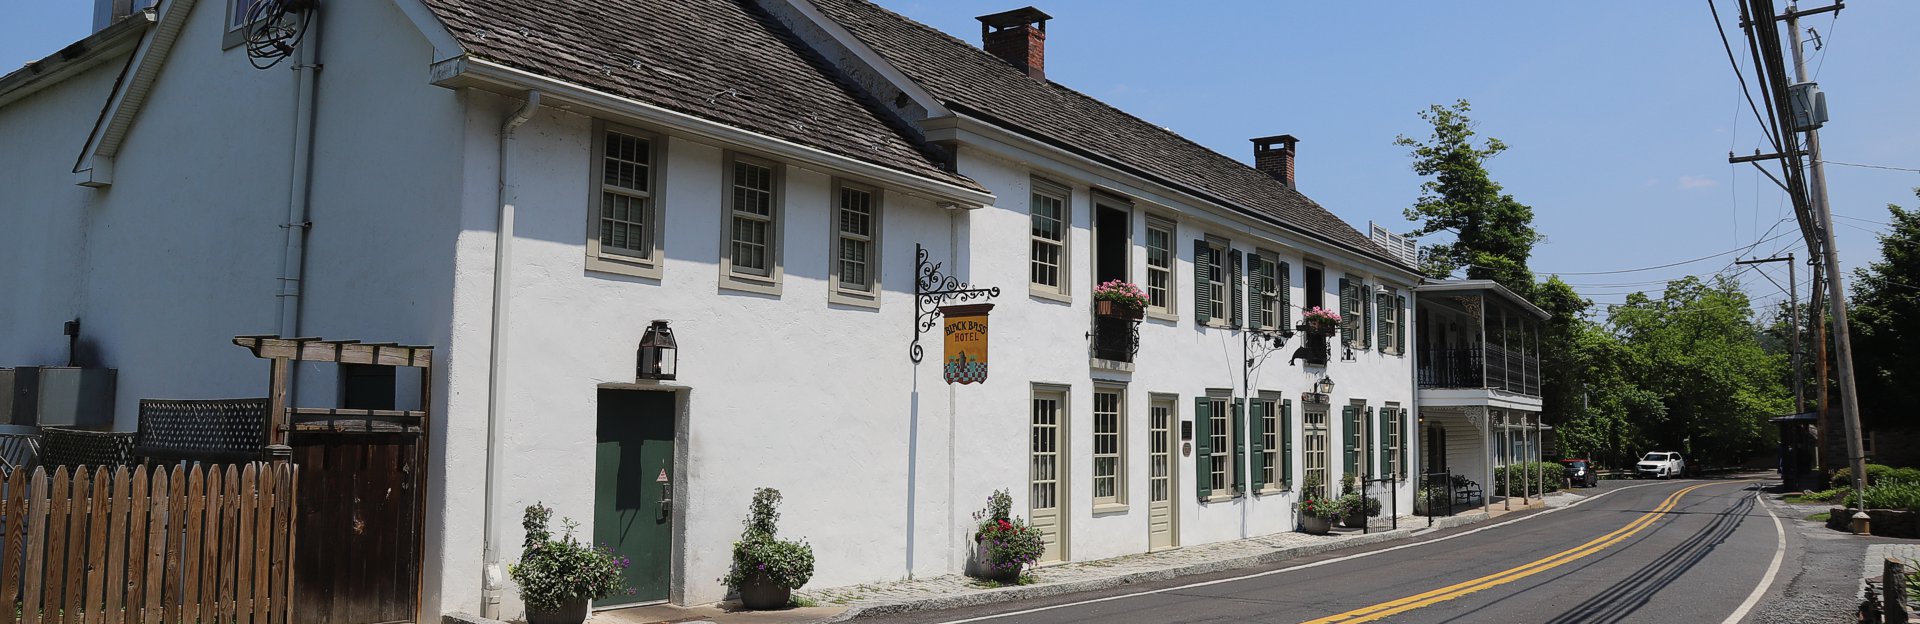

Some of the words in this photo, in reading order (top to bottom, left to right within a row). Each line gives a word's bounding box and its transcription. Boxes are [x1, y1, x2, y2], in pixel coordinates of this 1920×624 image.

[945, 321, 966, 336] BLACK
[968, 320, 987, 335] BASS
[954, 332, 979, 342] HOTEL
